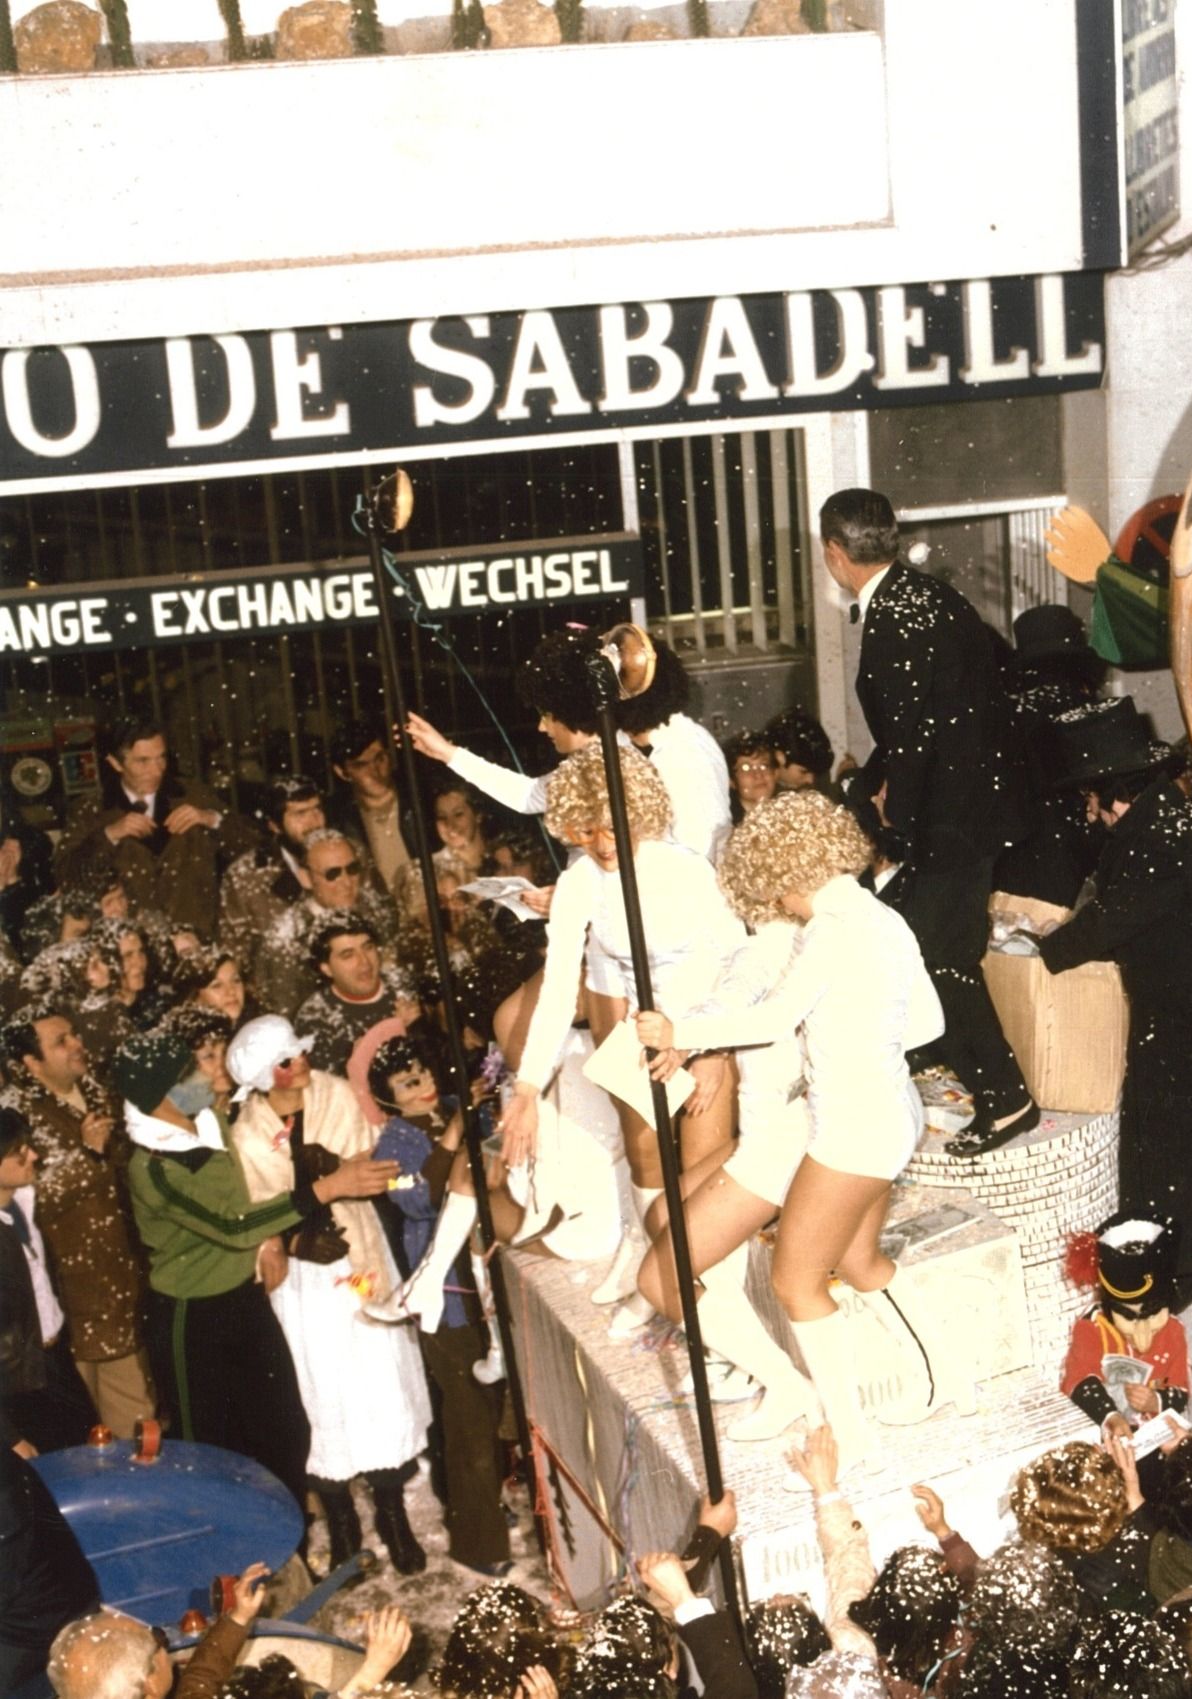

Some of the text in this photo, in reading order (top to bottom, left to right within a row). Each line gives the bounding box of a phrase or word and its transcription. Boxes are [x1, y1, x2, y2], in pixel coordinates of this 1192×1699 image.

[2, 274, 1101, 458] O DE SABADELL
[0, 549, 629, 652] ANGE EXCHANGE WECHSEL
